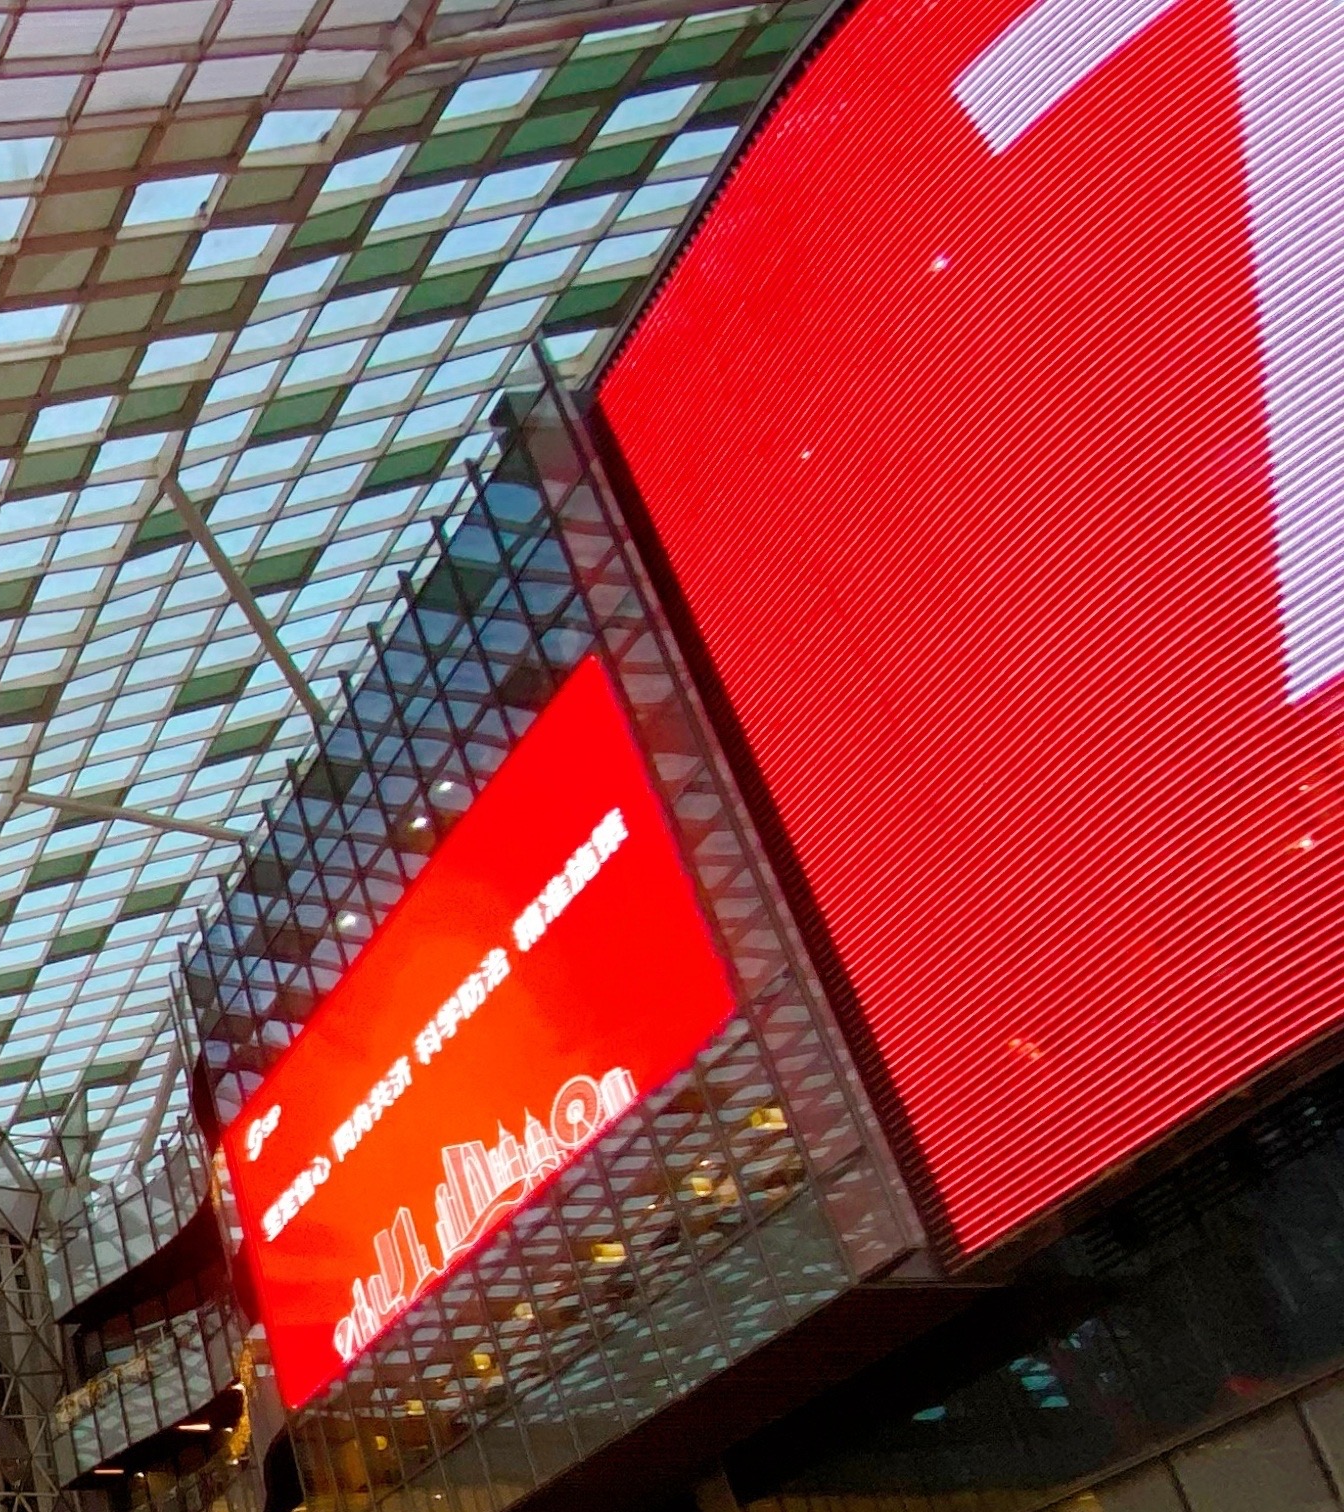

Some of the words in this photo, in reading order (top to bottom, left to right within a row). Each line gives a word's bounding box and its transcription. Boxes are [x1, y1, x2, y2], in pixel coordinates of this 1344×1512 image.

[332, 1055, 413, 1163] 同舟共济
[414, 947, 510, 1065] 科学防治
[512, 807, 629, 952] 精准施策
